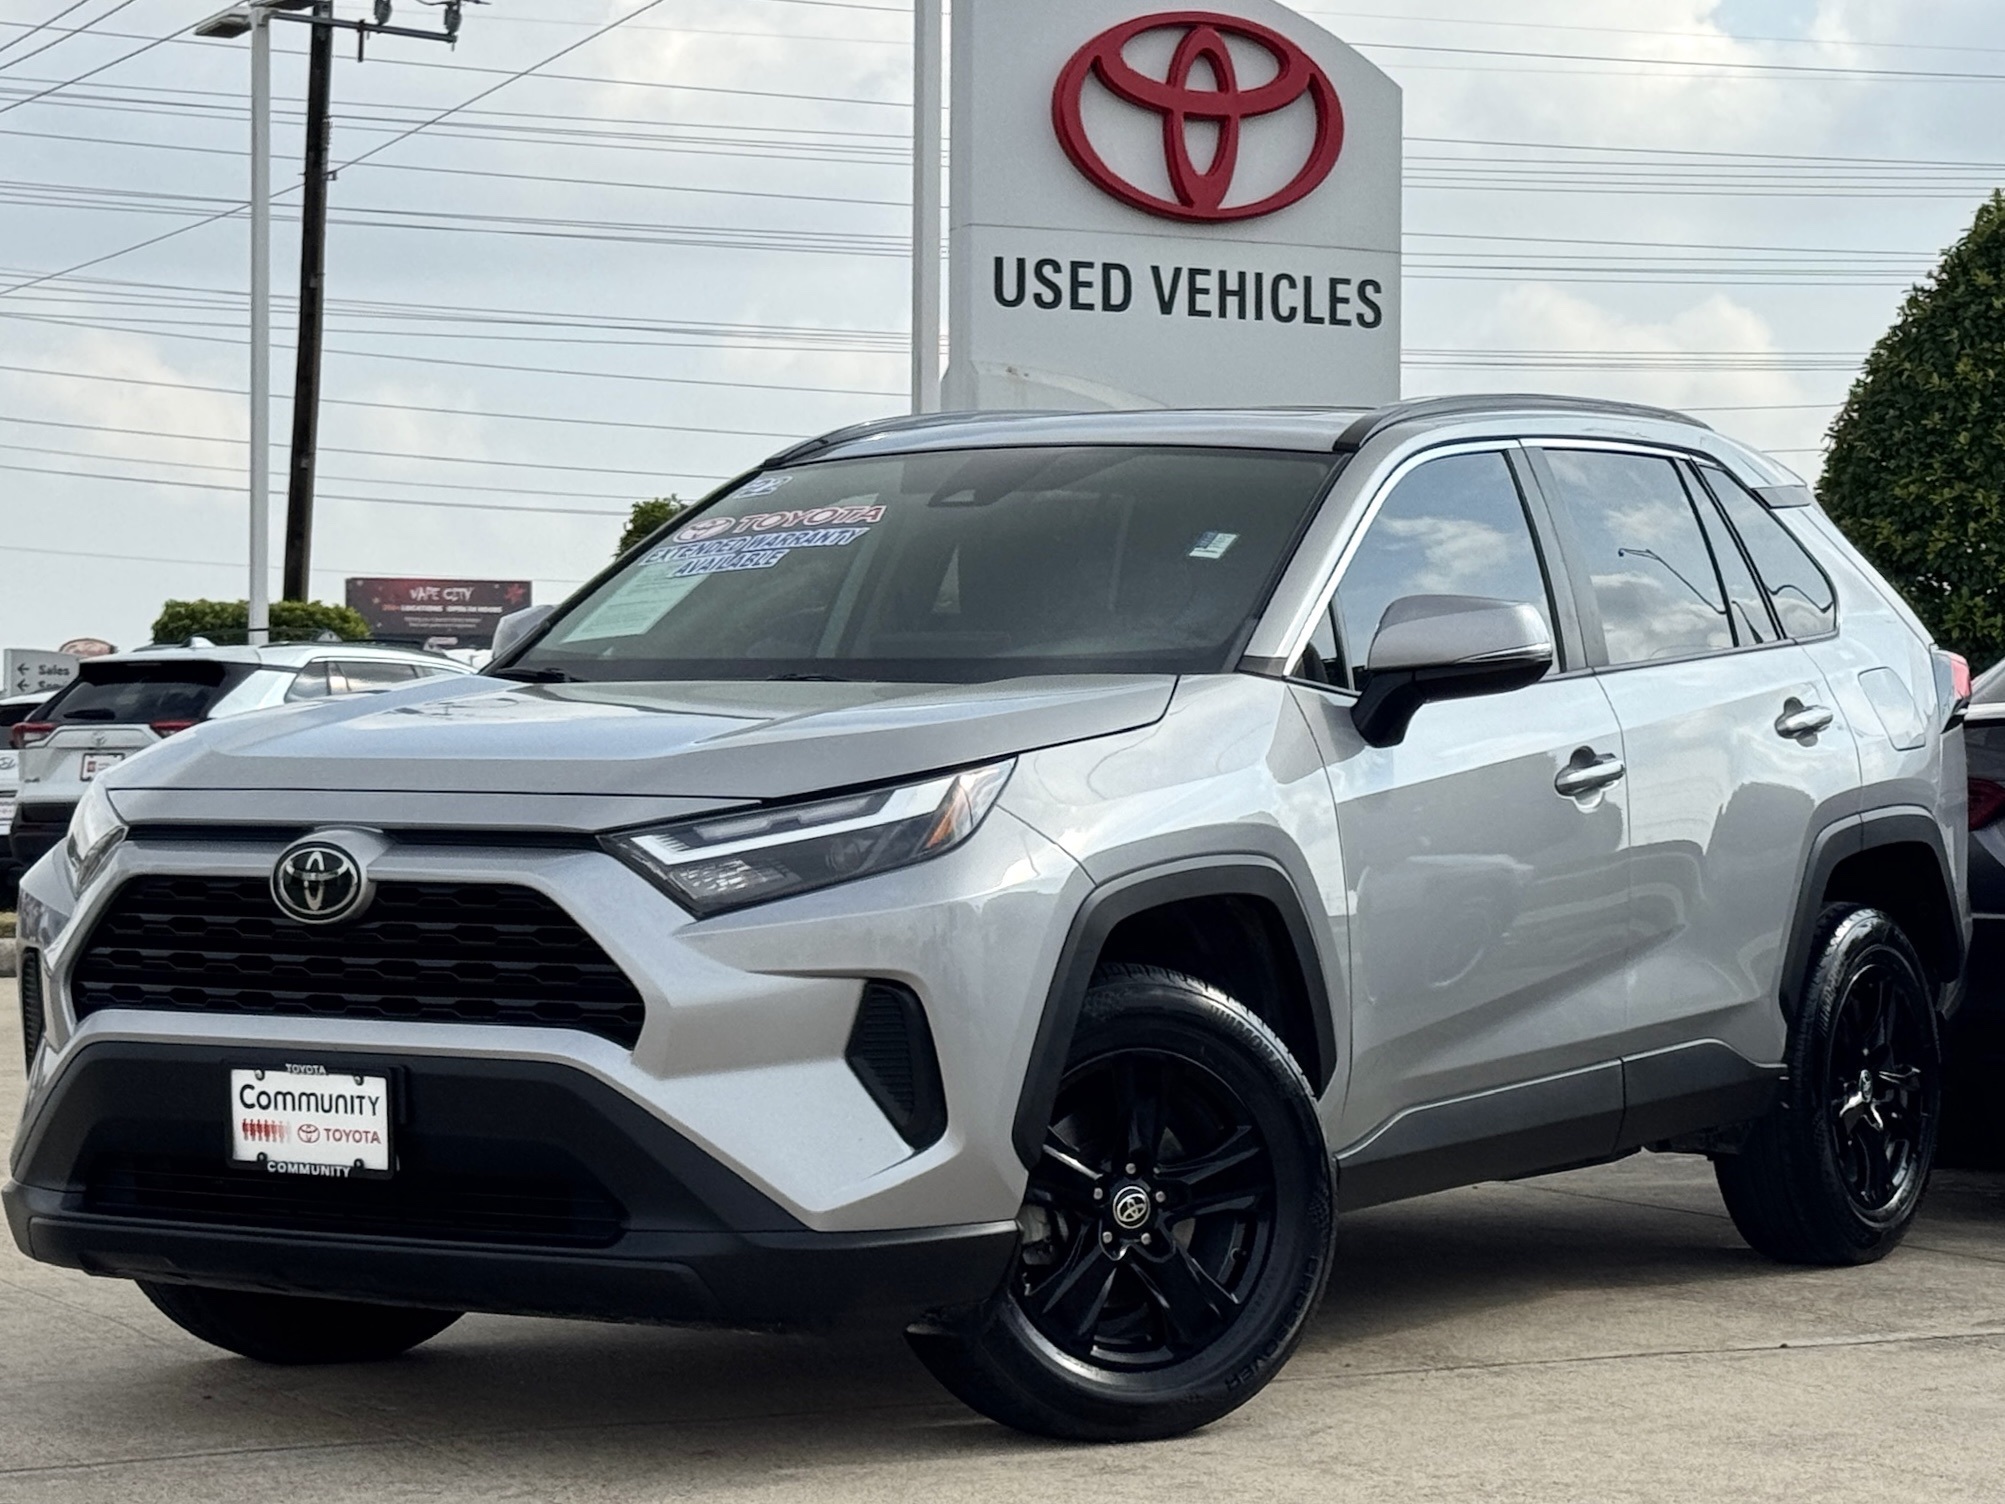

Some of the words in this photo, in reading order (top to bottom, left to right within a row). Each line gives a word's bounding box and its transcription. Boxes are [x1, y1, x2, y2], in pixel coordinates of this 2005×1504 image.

[993, 256, 1132, 312] USED
[1150, 265, 1383, 329] VEHICLES
[733, 505, 887, 533] TOYOTA
[640, 537, 751, 566] EXTENDED
[743, 528, 868, 552] WARRANTY
[672, 549, 790, 577] AVAILABLE
[409, 586, 441, 601] VAPE
[442, 587, 475, 601] CITY
[38, 664, 71, 676] Sales
[285, 1063, 328, 1076] TOYOTA
[323, 1127, 382, 1145] TOYOTA
[266, 1160, 352, 1178] COMMUNITY
